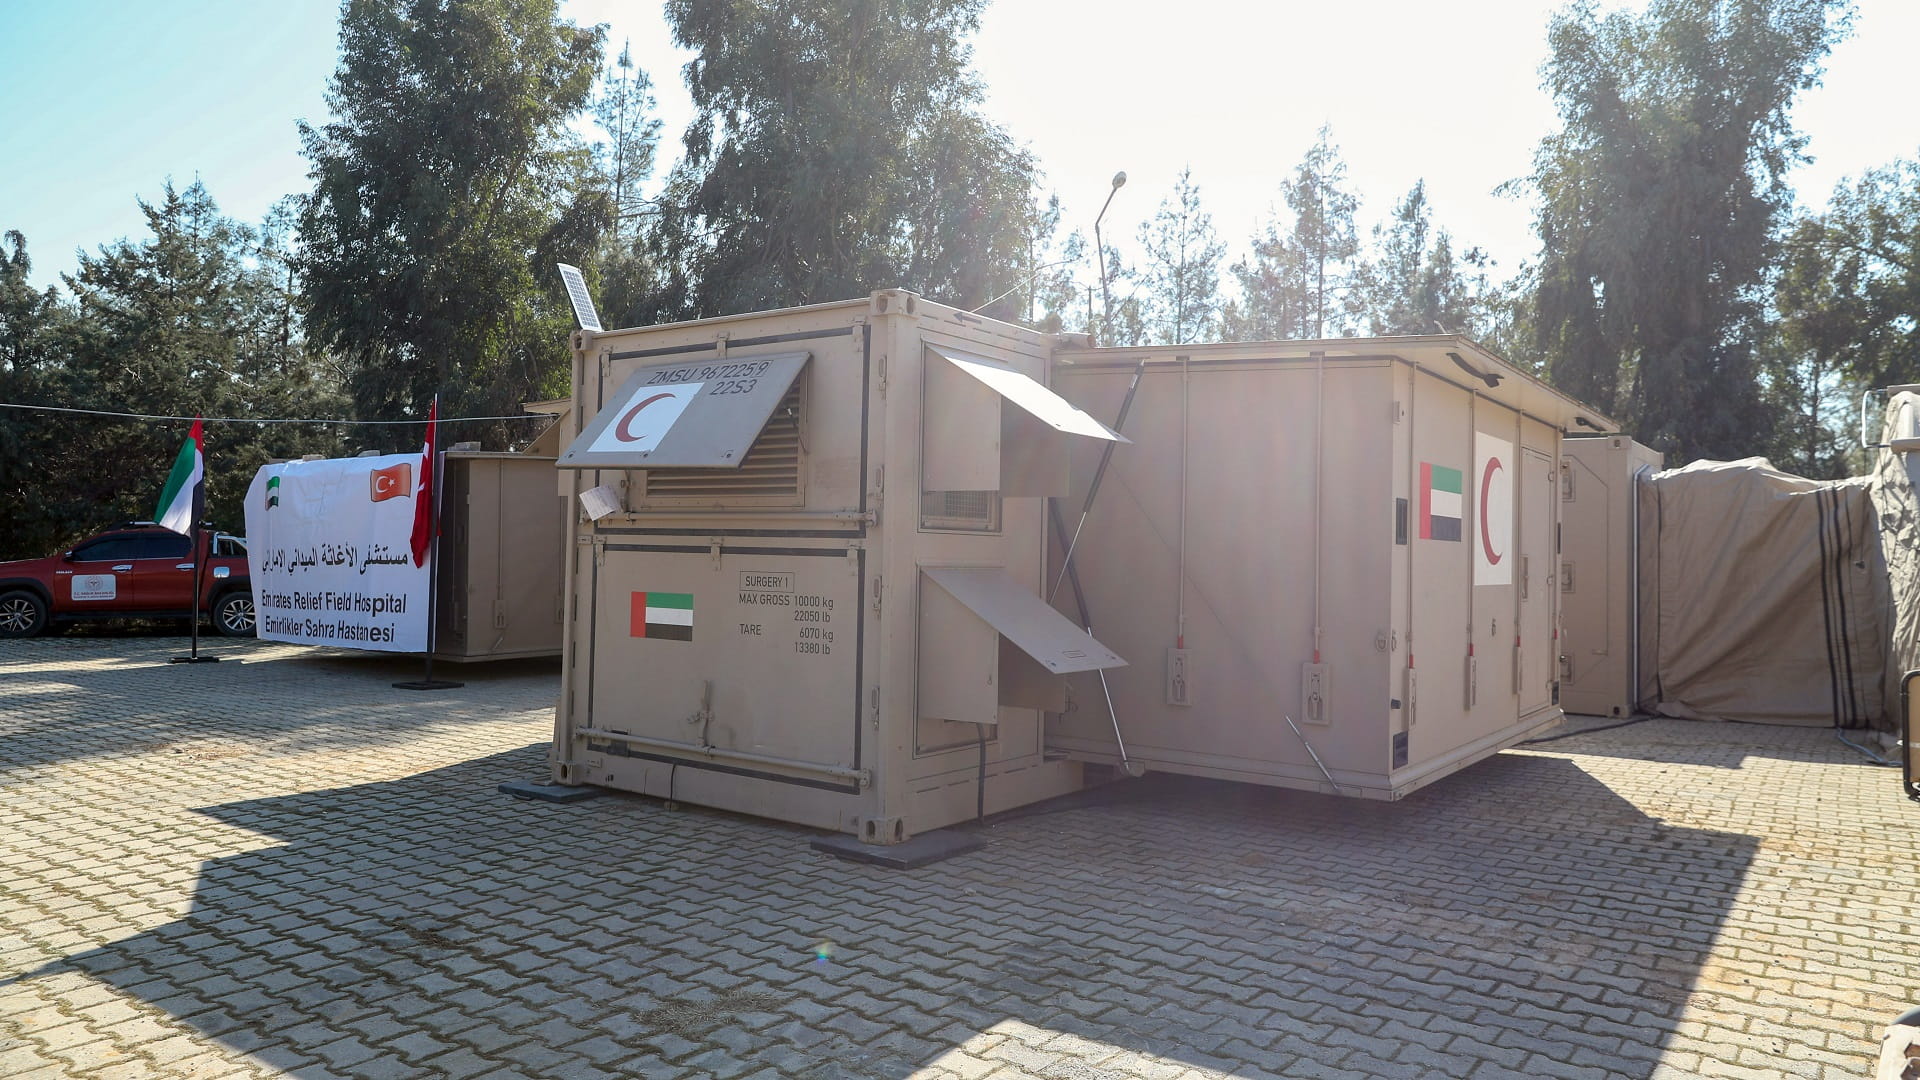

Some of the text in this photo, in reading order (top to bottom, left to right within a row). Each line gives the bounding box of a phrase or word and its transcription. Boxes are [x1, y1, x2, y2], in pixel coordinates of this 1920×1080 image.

[647, 368, 698, 385] ZMSU
[287, 546, 319, 577] الميداني
[359, 543, 409, 576] مستشفى
[745, 575, 783, 588] SURGERY
[261, 588, 407, 618] Emirates Relief Field Hospital
[739, 593, 834, 611] MAX GROSS 10000 kg
[794, 610, 831, 623] 22050 lb
[265, 615, 395, 643] Emirlikler Sahra Hastanesi
[739, 623, 834, 643] TARE 6070 kg
[794, 641, 831, 655] 13380 lb
